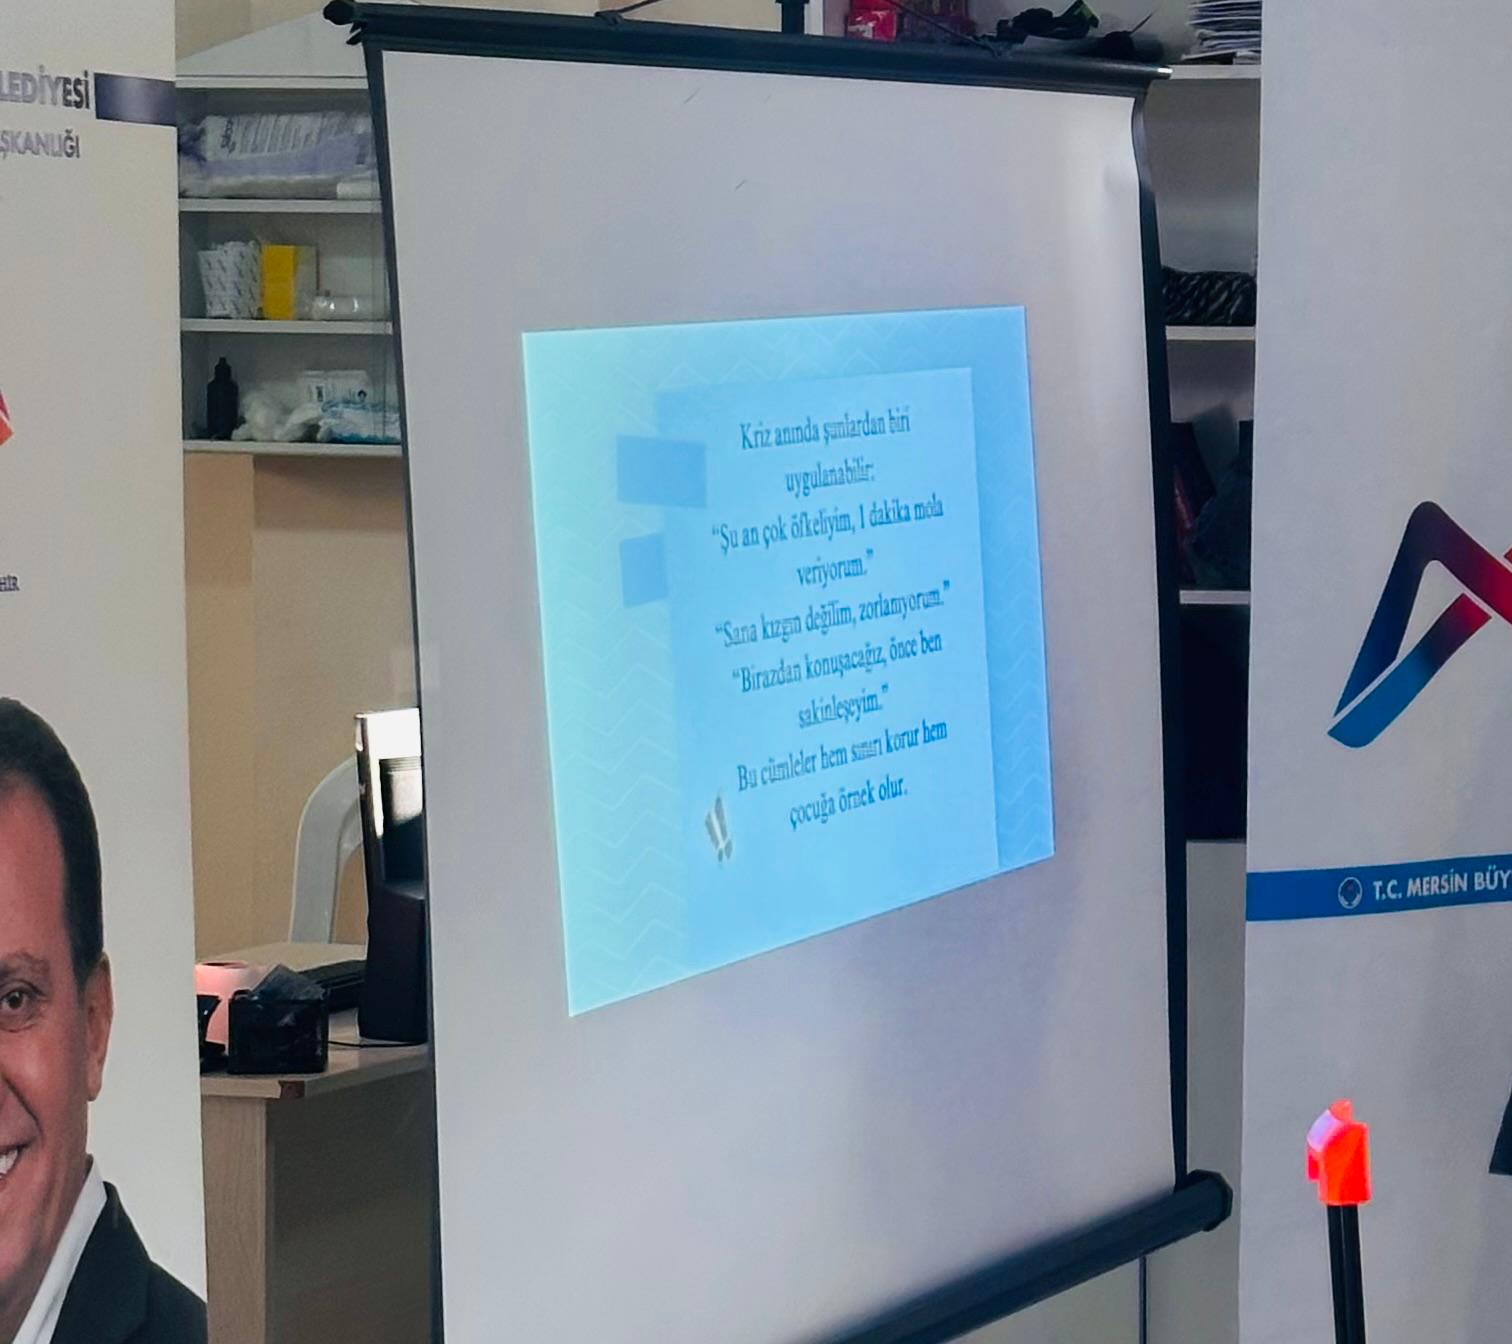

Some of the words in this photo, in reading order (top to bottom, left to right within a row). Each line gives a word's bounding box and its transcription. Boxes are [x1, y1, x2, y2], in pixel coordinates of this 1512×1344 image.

[740, 421, 772, 449] Kriz
[775, 416, 819, 446] anında
[824, 411, 885, 444] şunlardan
[889, 406, 910, 434] biri
[786, 456, 874, 498] uygulanabilir:
[742, 527, 759, 547] an
[763, 515, 787, 548] çok
[791, 507, 855, 541] öfkeliyim,
[869, 499, 910, 527] dakika
[914, 492, 943, 520] mola
[797, 548, 873, 588] veriyorum.”
[761, 613, 801, 642] kızgın
[805, 600, 856, 635] değilim,
[805, 642, 887, 678] konuşacağız,
[890, 638, 917, 661] önce
[921, 629, 942, 654] ben
[737, 765, 757, 791] Bu
[761, 749, 816, 785] cümleler
[821, 744, 847, 769] hem
[885, 729, 921, 753] korur
[923, 719, 947, 744] hem
[790, 792, 835, 831] çocuğa
[839, 778, 875, 813] örnek
[879, 774, 908, 801] olur.
[1373, 878, 1402, 900] T.C.
[1407, 868, 1467, 898] MERSİN
